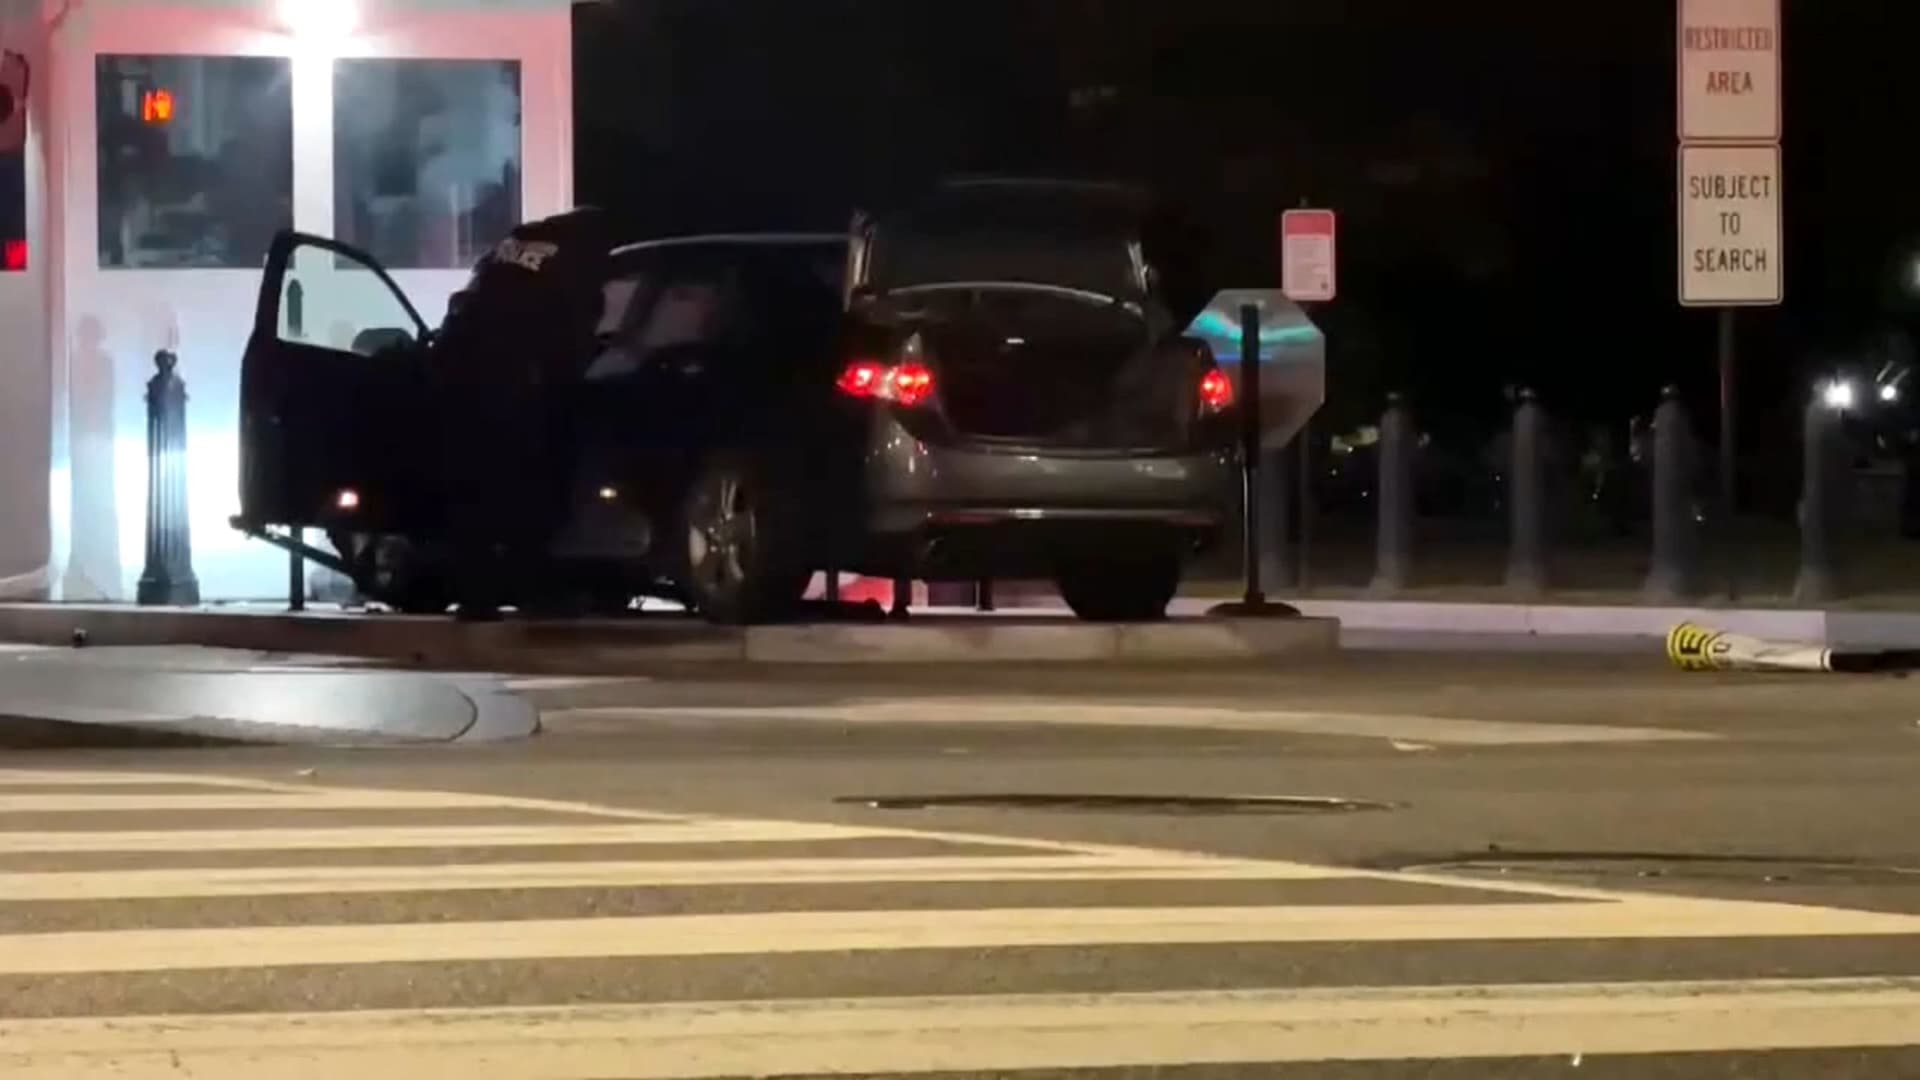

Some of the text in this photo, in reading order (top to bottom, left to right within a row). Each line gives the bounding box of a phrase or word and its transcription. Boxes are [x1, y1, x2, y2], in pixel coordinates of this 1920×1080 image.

[1685, 27, 1773, 51] RESTRICTED
[1705, 71, 1754, 94] AREA
[1689, 175, 1771, 199] SUBJECT
[1720, 211, 1741, 236] TO
[1693, 248, 1767, 272] SEARCH
